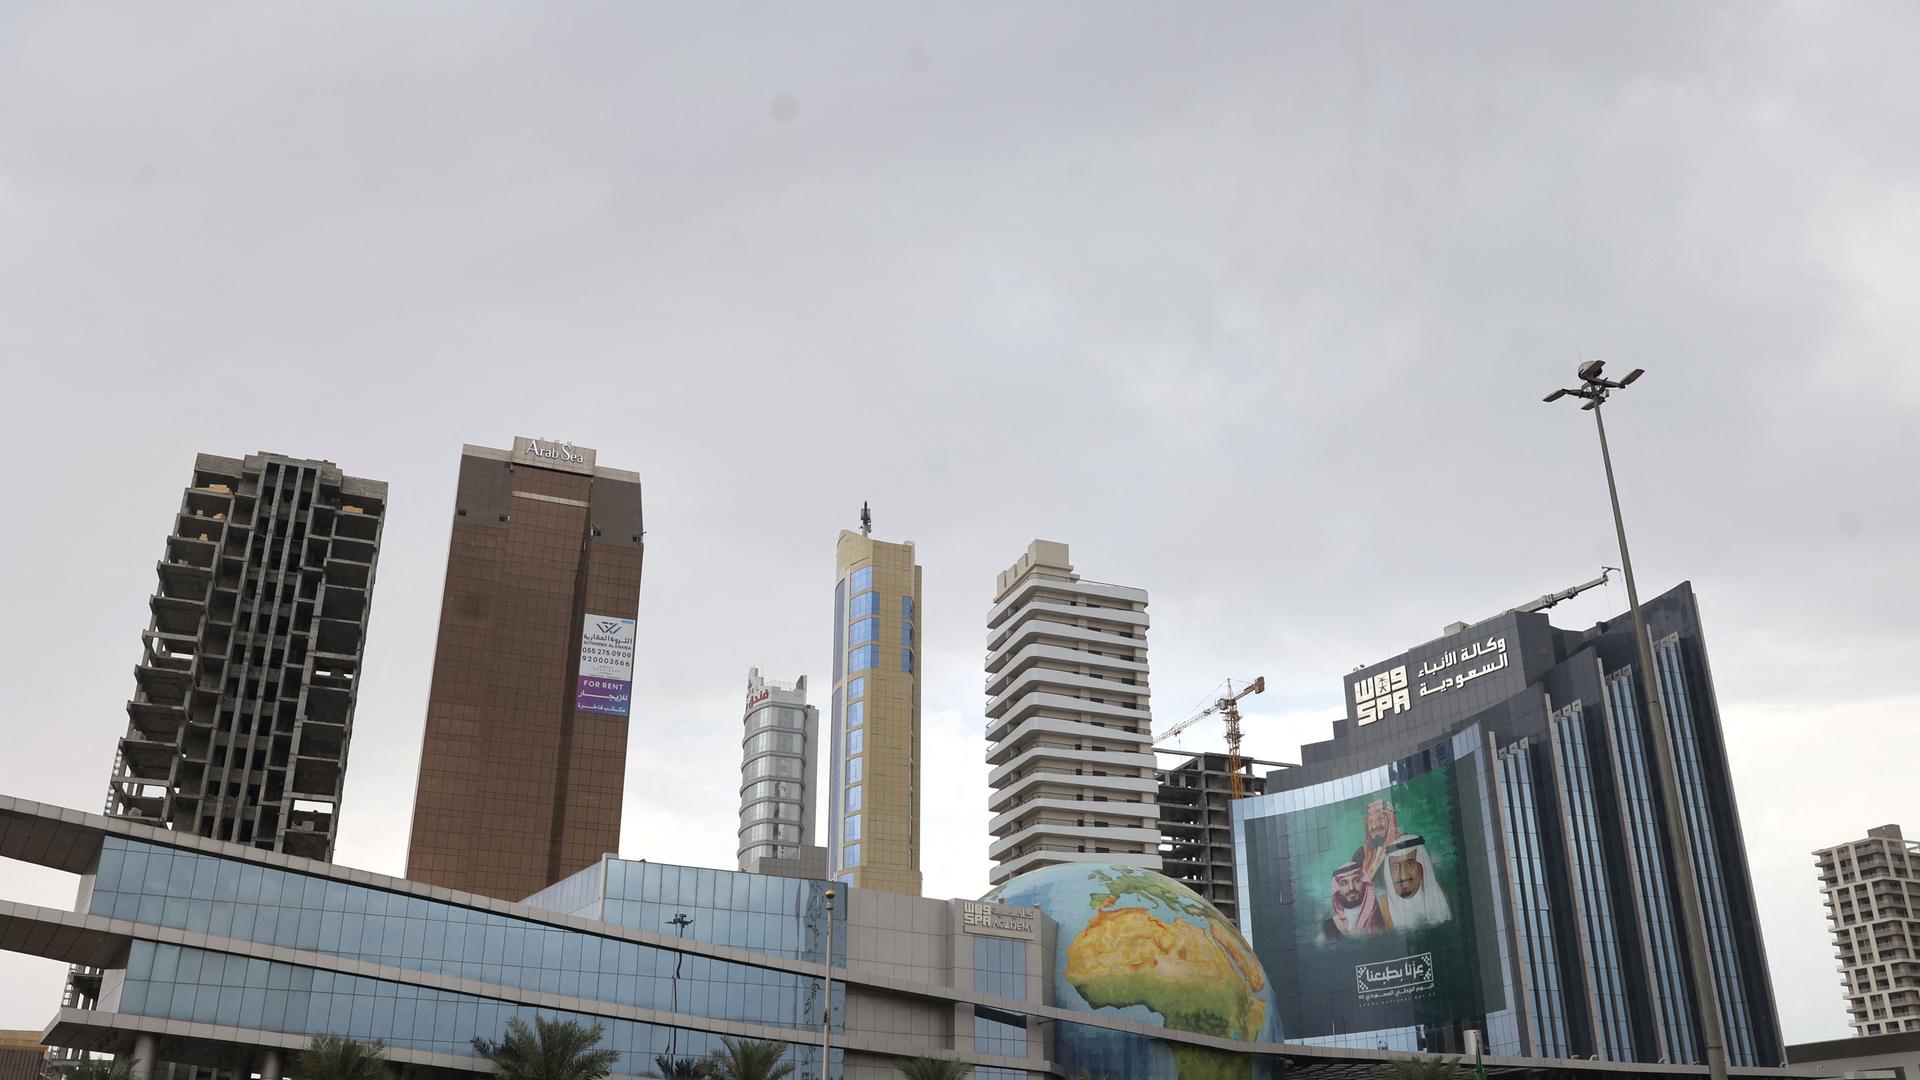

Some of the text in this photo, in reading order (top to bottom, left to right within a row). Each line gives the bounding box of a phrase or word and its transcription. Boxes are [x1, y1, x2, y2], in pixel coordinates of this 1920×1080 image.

[525, 440, 583, 463] Arab Sea
[582, 655, 630, 667] 920003566
[1418, 637, 1506, 677] وكالة الأنباء
[1420, 653, 1509, 696] السعودية
[583, 680, 624, 690] FOR RENT
[1356, 687, 1411, 727] SPA
[964, 913, 991, 927] SPA
[992, 920, 1033, 932] ACADEMY
[1366, 966, 1402, 985] بطبعنا
